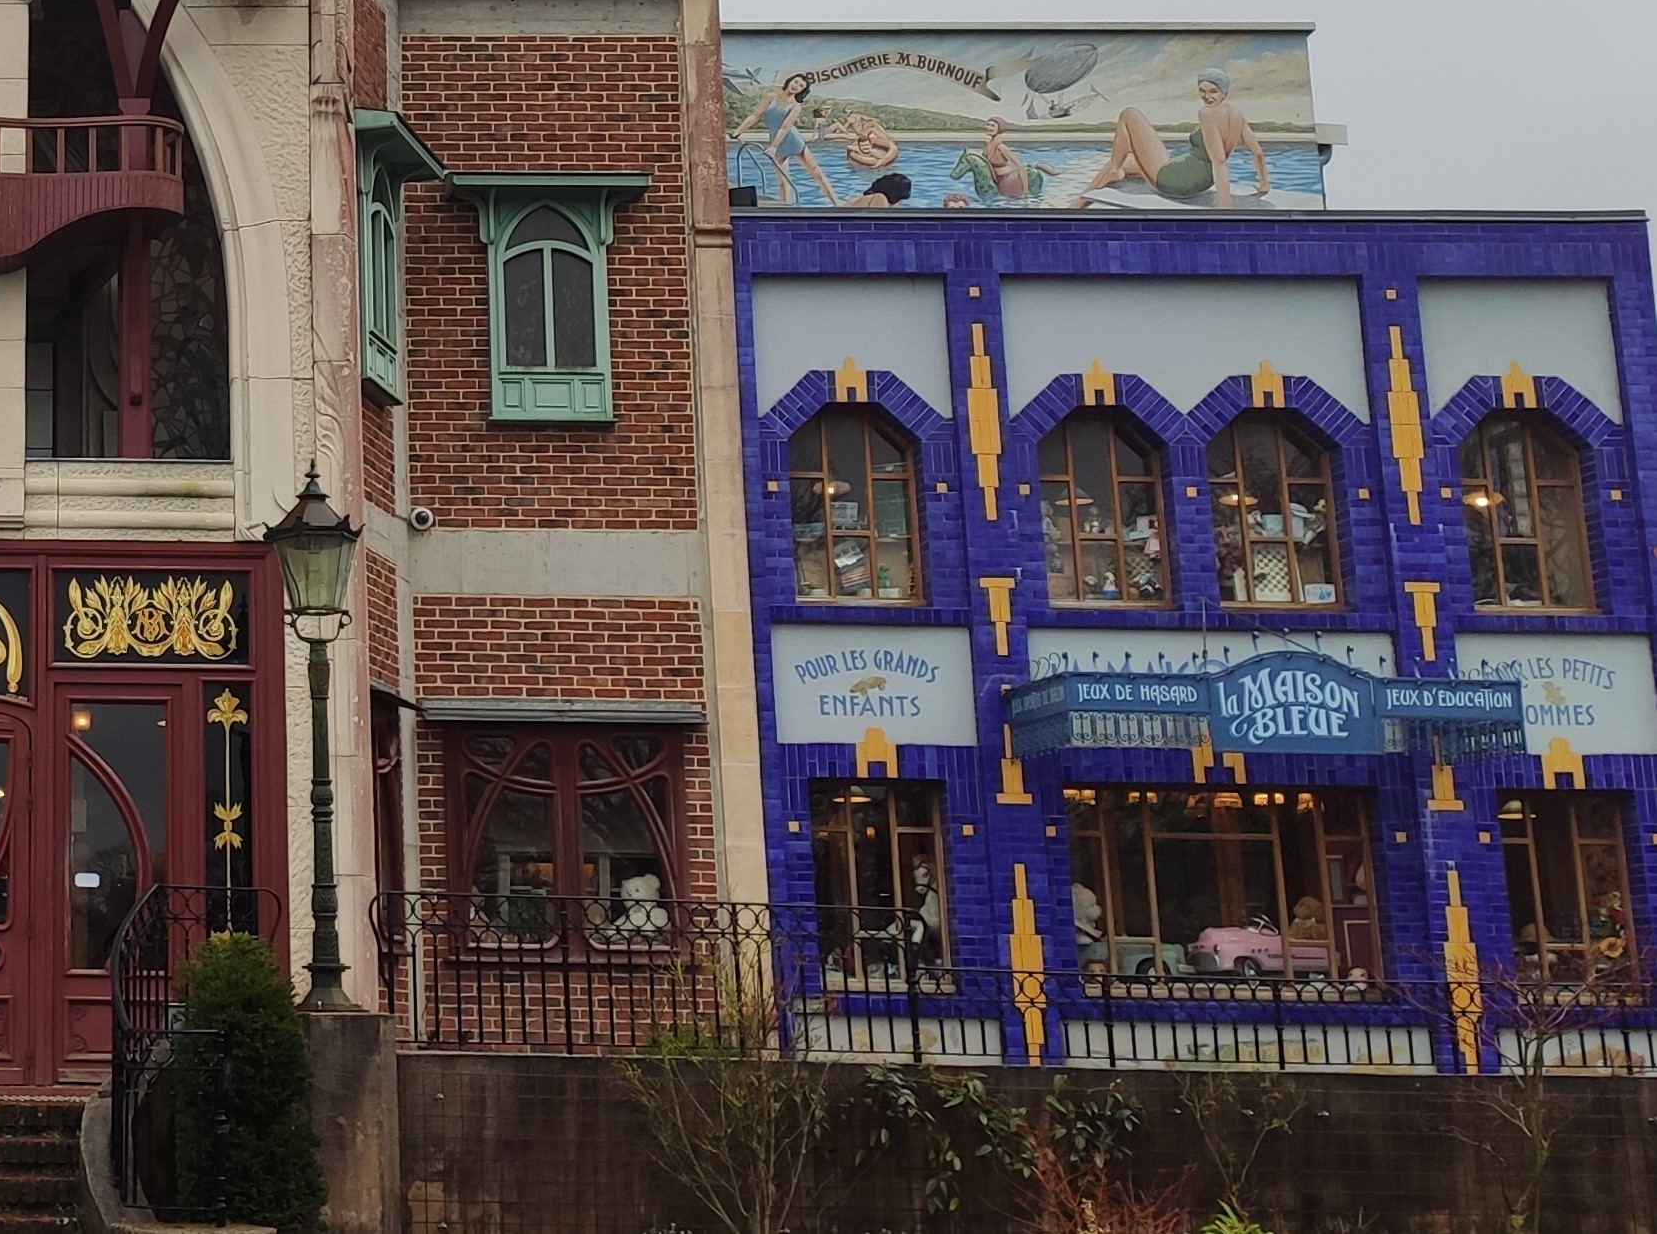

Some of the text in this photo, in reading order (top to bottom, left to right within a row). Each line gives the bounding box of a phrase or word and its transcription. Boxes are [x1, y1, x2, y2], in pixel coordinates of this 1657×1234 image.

[806, 53, 891, 85] BISCUITERIE
[794, 649, 940, 685] POUR LES GRANDS
[1528, 657, 1555, 680] LES
[1562, 658, 1617, 690] PETITS
[819, 694, 921, 717] ENFANTS
[1078, 683, 1111, 703] JEUX
[1116, 684, 1134, 701] DE
[1140, 684, 1198, 706] HASARD
[1216, 667, 1362, 737] la MAISON
[1386, 687, 1513, 712] JEUX D'EDUCATION
[1246, 705, 1351, 746] BLEUE
